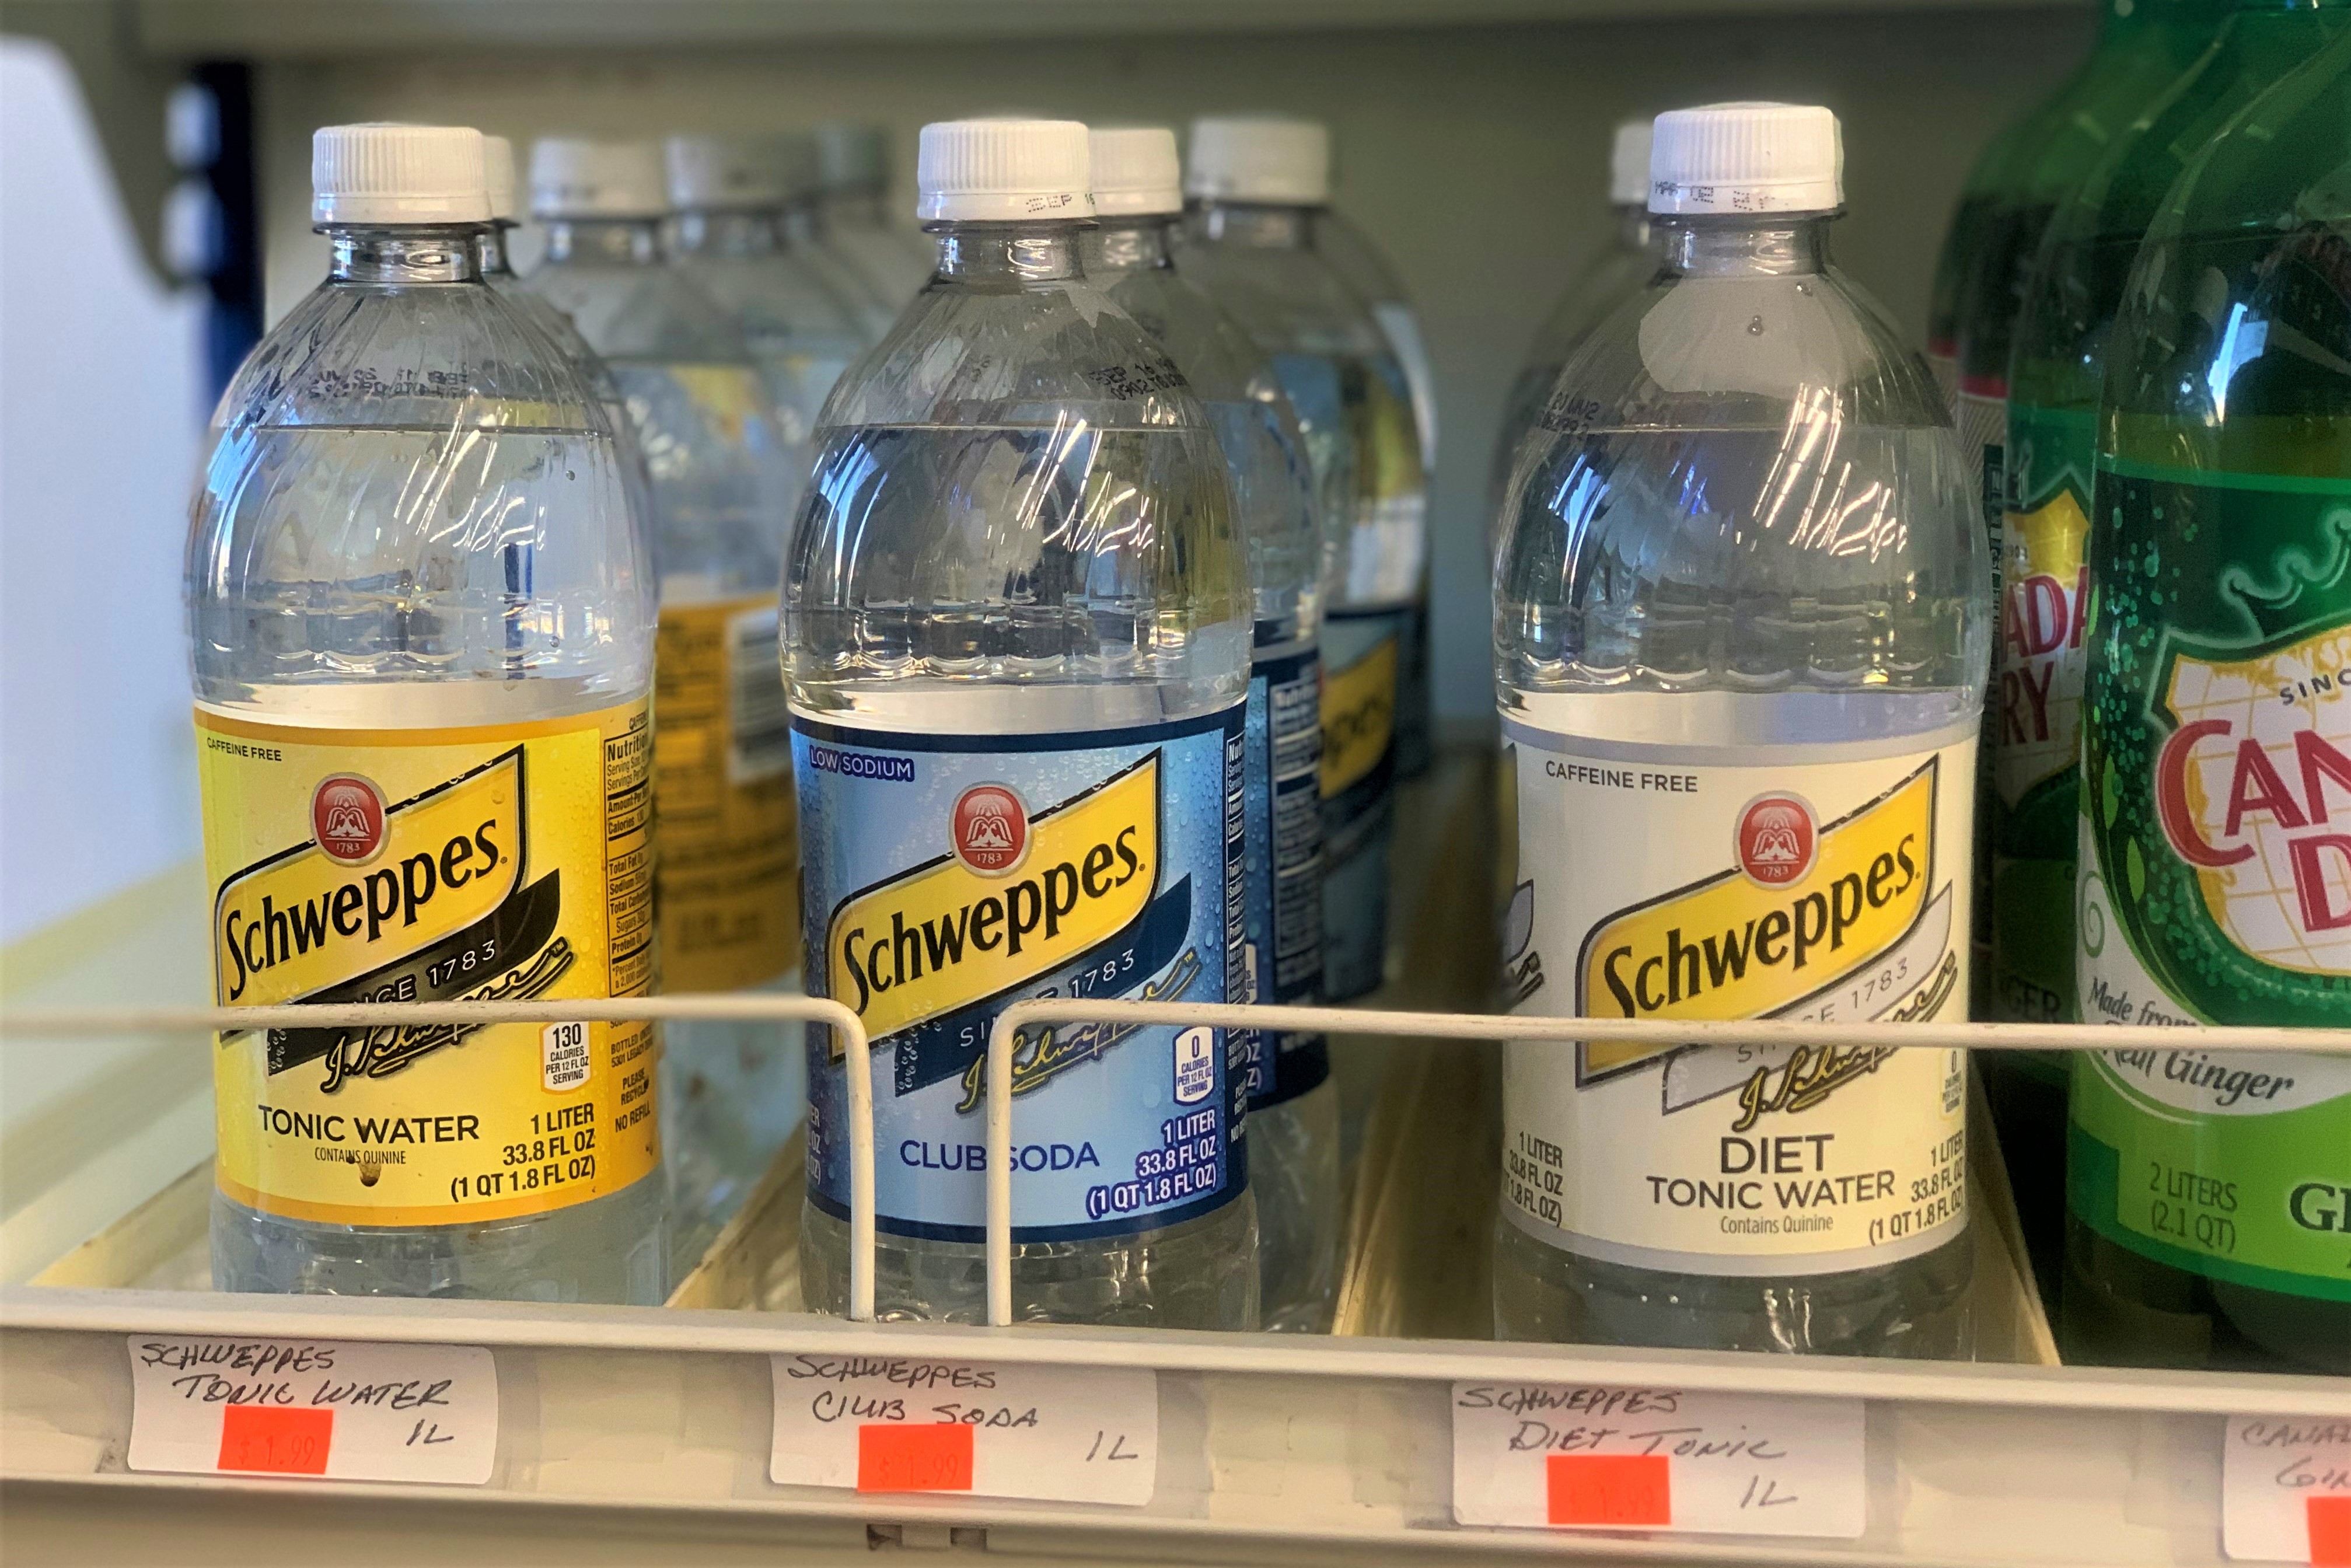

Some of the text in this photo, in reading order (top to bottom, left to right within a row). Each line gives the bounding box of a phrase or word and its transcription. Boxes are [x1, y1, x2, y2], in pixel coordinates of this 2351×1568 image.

[207, 737, 282, 762] CAFFEINE FREE
[810, 747, 912, 779] LOW SODIUM
[1546, 760, 1697, 792] CAFFEINE FREE
[608, 817, 635, 834] Calories
[336, 842, 361, 853] 1783
[978, 853, 1002, 864] 1783
[609, 860, 627, 875] Total
[1763, 865, 1788, 876] 1783
[226, 819, 499, 1001] Schweppes
[610, 900, 627, 915] Total
[844, 826, 1138, 1016] Schweppes
[1604, 834, 1915, 1019] Schweppes
[612, 937, 635, 954] Protein
[430, 939, 496, 986] 1783
[1071, 948, 1136, 998] 1783
[1851, 956, 1908, 1009] 1783
[2088, 975, 2133, 1021] Made
[553, 1023, 582, 1049] 130
[1192, 1035, 1200, 1058] 0
[546, 1056, 589, 1074] PER 12 FL OZ
[550, 1046, 584, 1061] CALORIES
[1182, 1056, 1209, 1074] CALORIES
[553, 1069, 584, 1084] SERVING
[623, 1067, 645, 1090] PLEASE
[1178, 1066, 1212, 1087] PER 12 FL OZ
[1183, 1080, 1208, 1096] SERVING
[2165, 1050, 2294, 1106] Ginger
[258, 1105, 479, 1144] TONIC WATER
[530, 1102, 594, 1135] 1 LITER
[615, 1115, 627, 1133] NO
[1164, 1123, 1173, 1143] 1
[1178, 1109, 1215, 1139] LITER
[315, 1147, 406, 1165] CONTAINS QUININE
[503, 1129, 595, 1166] 33.8 FL OZ
[900, 1140, 986, 1169] CLUB
[1139, 1135, 1216, 1176] 33.8 FL OZ
[1519, 1131, 1563, 1169] 1 LITER
[1721, 1133, 1835, 1174] DIET
[1931, 1146, 1937, 1167] 1
[451, 1155, 596, 1202] (1 QT 1.8 FL OZ)
[1089, 1162, 1217, 1217] (1 QT 1.8 FL OZ)
[1528, 1162, 1542, 1188] FL
[1545, 1170, 1563, 1196] OZ
[1646, 1169, 1895, 1210] TONIC WATER
[1911, 1174, 1939, 1203] 33.8
[1941, 1167, 1952, 1191] FL
[2150, 1161, 2238, 1213] 2 LITERS
[1524, 1188, 1537, 1213] FL
[1539, 1195, 1563, 1228] OZ)
[1720, 1214, 1833, 1234] Contains Quinine
[1869, 1218, 1884, 1246] (1
[1890, 1211, 1912, 1237] QT
[1916, 1203, 1935, 1229] 1.8
[1937, 1197, 1950, 1221] FL
[2151, 1199, 2236, 1253] (2.1 QT)
[140, 1343, 336, 1375] SCHWEPPES
[787, 1354, 996, 1389] SCHWEPPES
[173, 1374, 454, 1410] TONIC WATER
[1458, 1388, 1682, 1416] SCHWEPPES
[932, 1403, 1039, 1428] SODA
